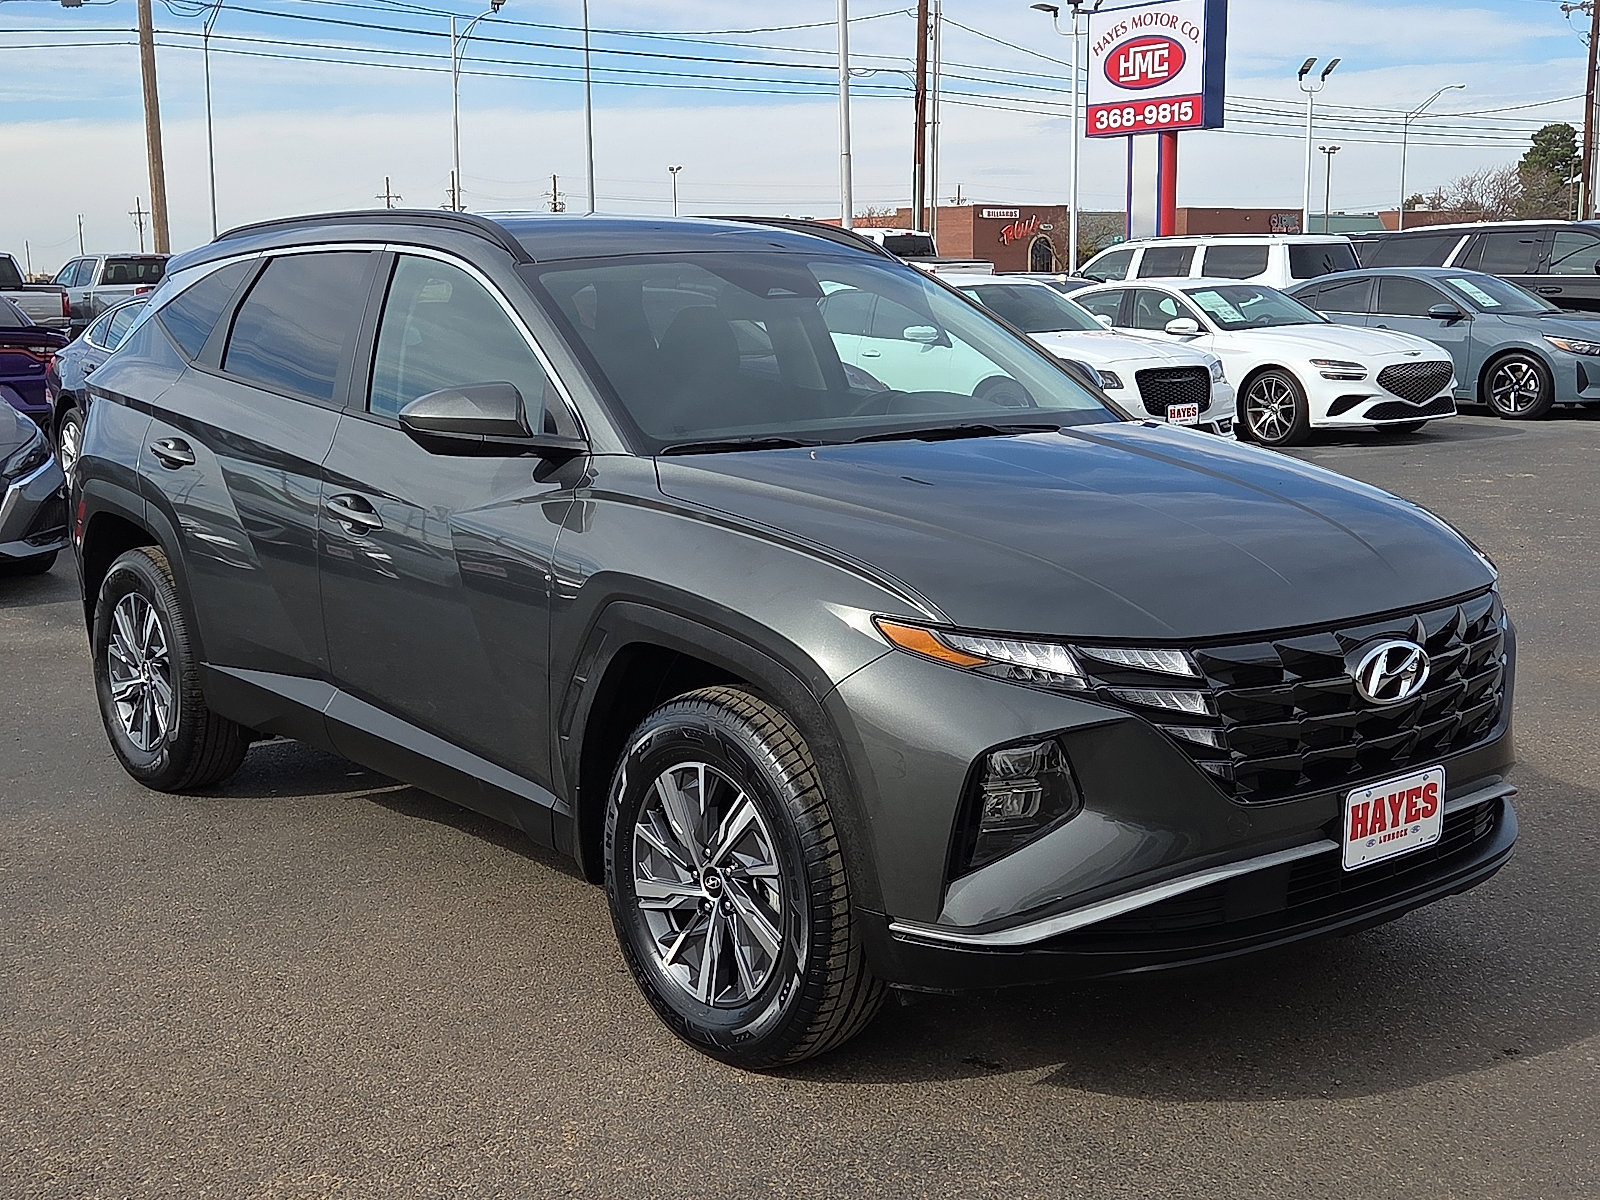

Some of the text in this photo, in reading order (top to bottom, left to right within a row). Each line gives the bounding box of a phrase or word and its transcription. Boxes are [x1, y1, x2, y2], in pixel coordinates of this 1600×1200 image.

[1093, 12, 1200, 56] HAYES MOTOR CO.
[1119, 42, 1170, 82] HMC
[1095, 101, 1193, 129] 368-9815
[1170, 407, 1197, 418] HAYES
[1350, 782, 1438, 841] HAYES
[1379, 828, 1408, 844] LUBBOCK
